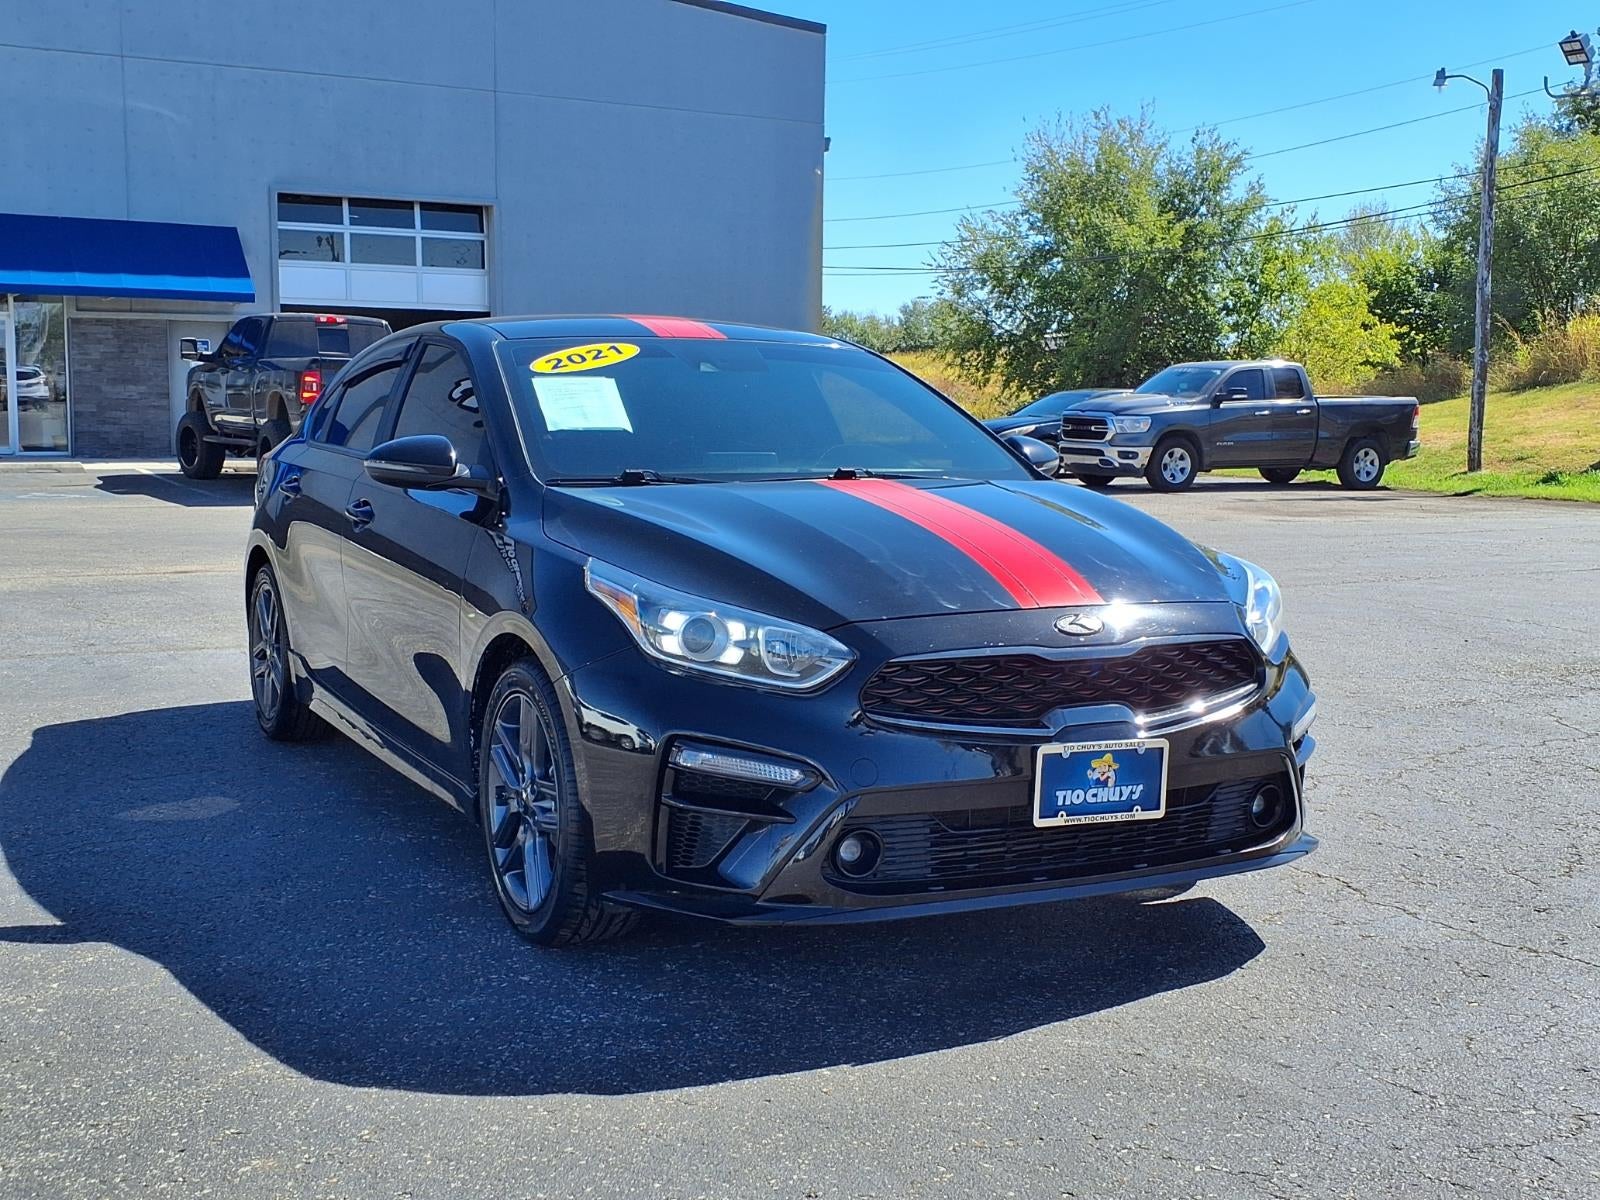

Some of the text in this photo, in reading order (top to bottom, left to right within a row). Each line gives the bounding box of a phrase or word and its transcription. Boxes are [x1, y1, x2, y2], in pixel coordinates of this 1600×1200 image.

[545, 345, 624, 370] 2021
[1077, 743, 1102, 751] CHUY'S
[1064, 813, 1136, 824] WWW.TIOCHUYS.COM
